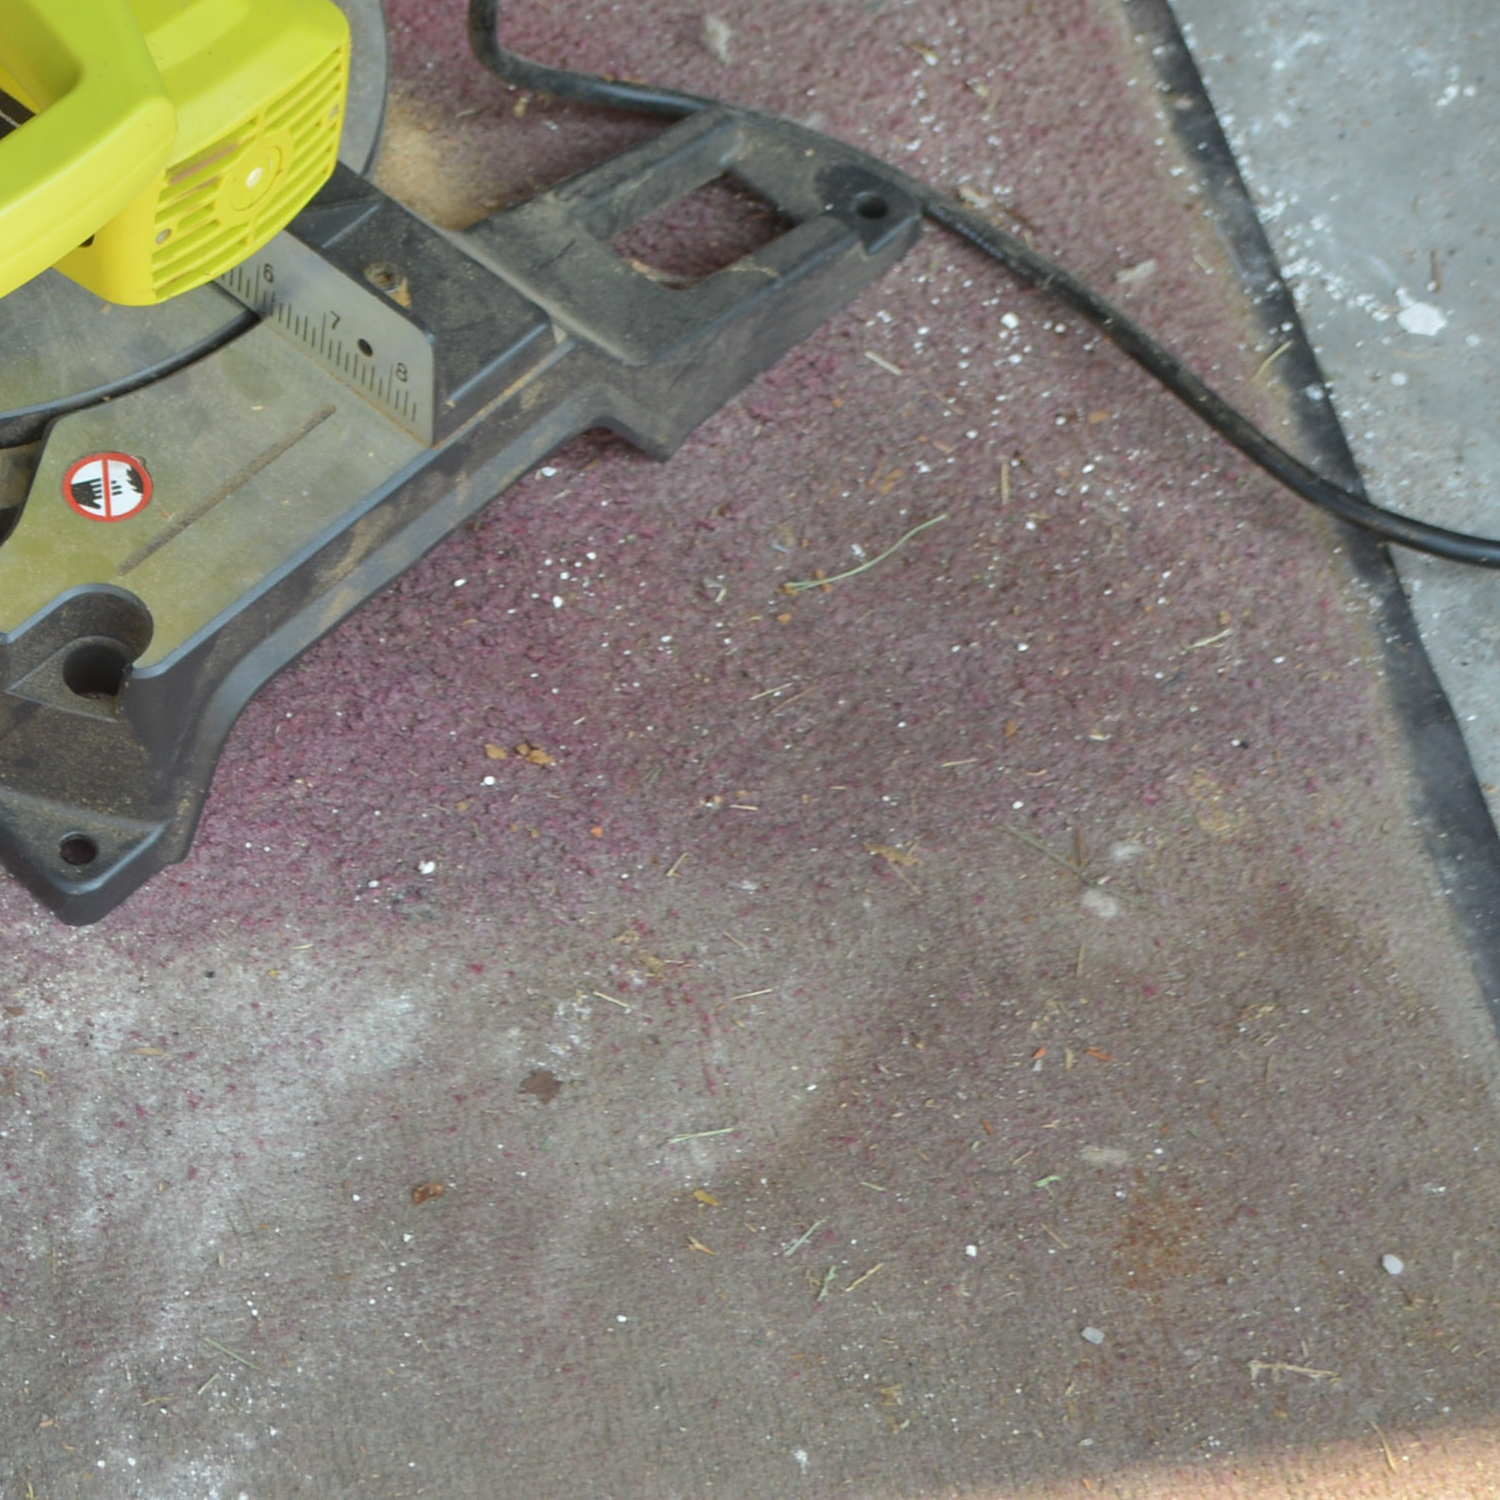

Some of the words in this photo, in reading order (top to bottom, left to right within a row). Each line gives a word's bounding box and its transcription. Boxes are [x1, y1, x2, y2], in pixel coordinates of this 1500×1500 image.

[263, 263, 274, 283] 6
[330, 310, 341, 330] 7
[395, 362, 408, 382] 8
